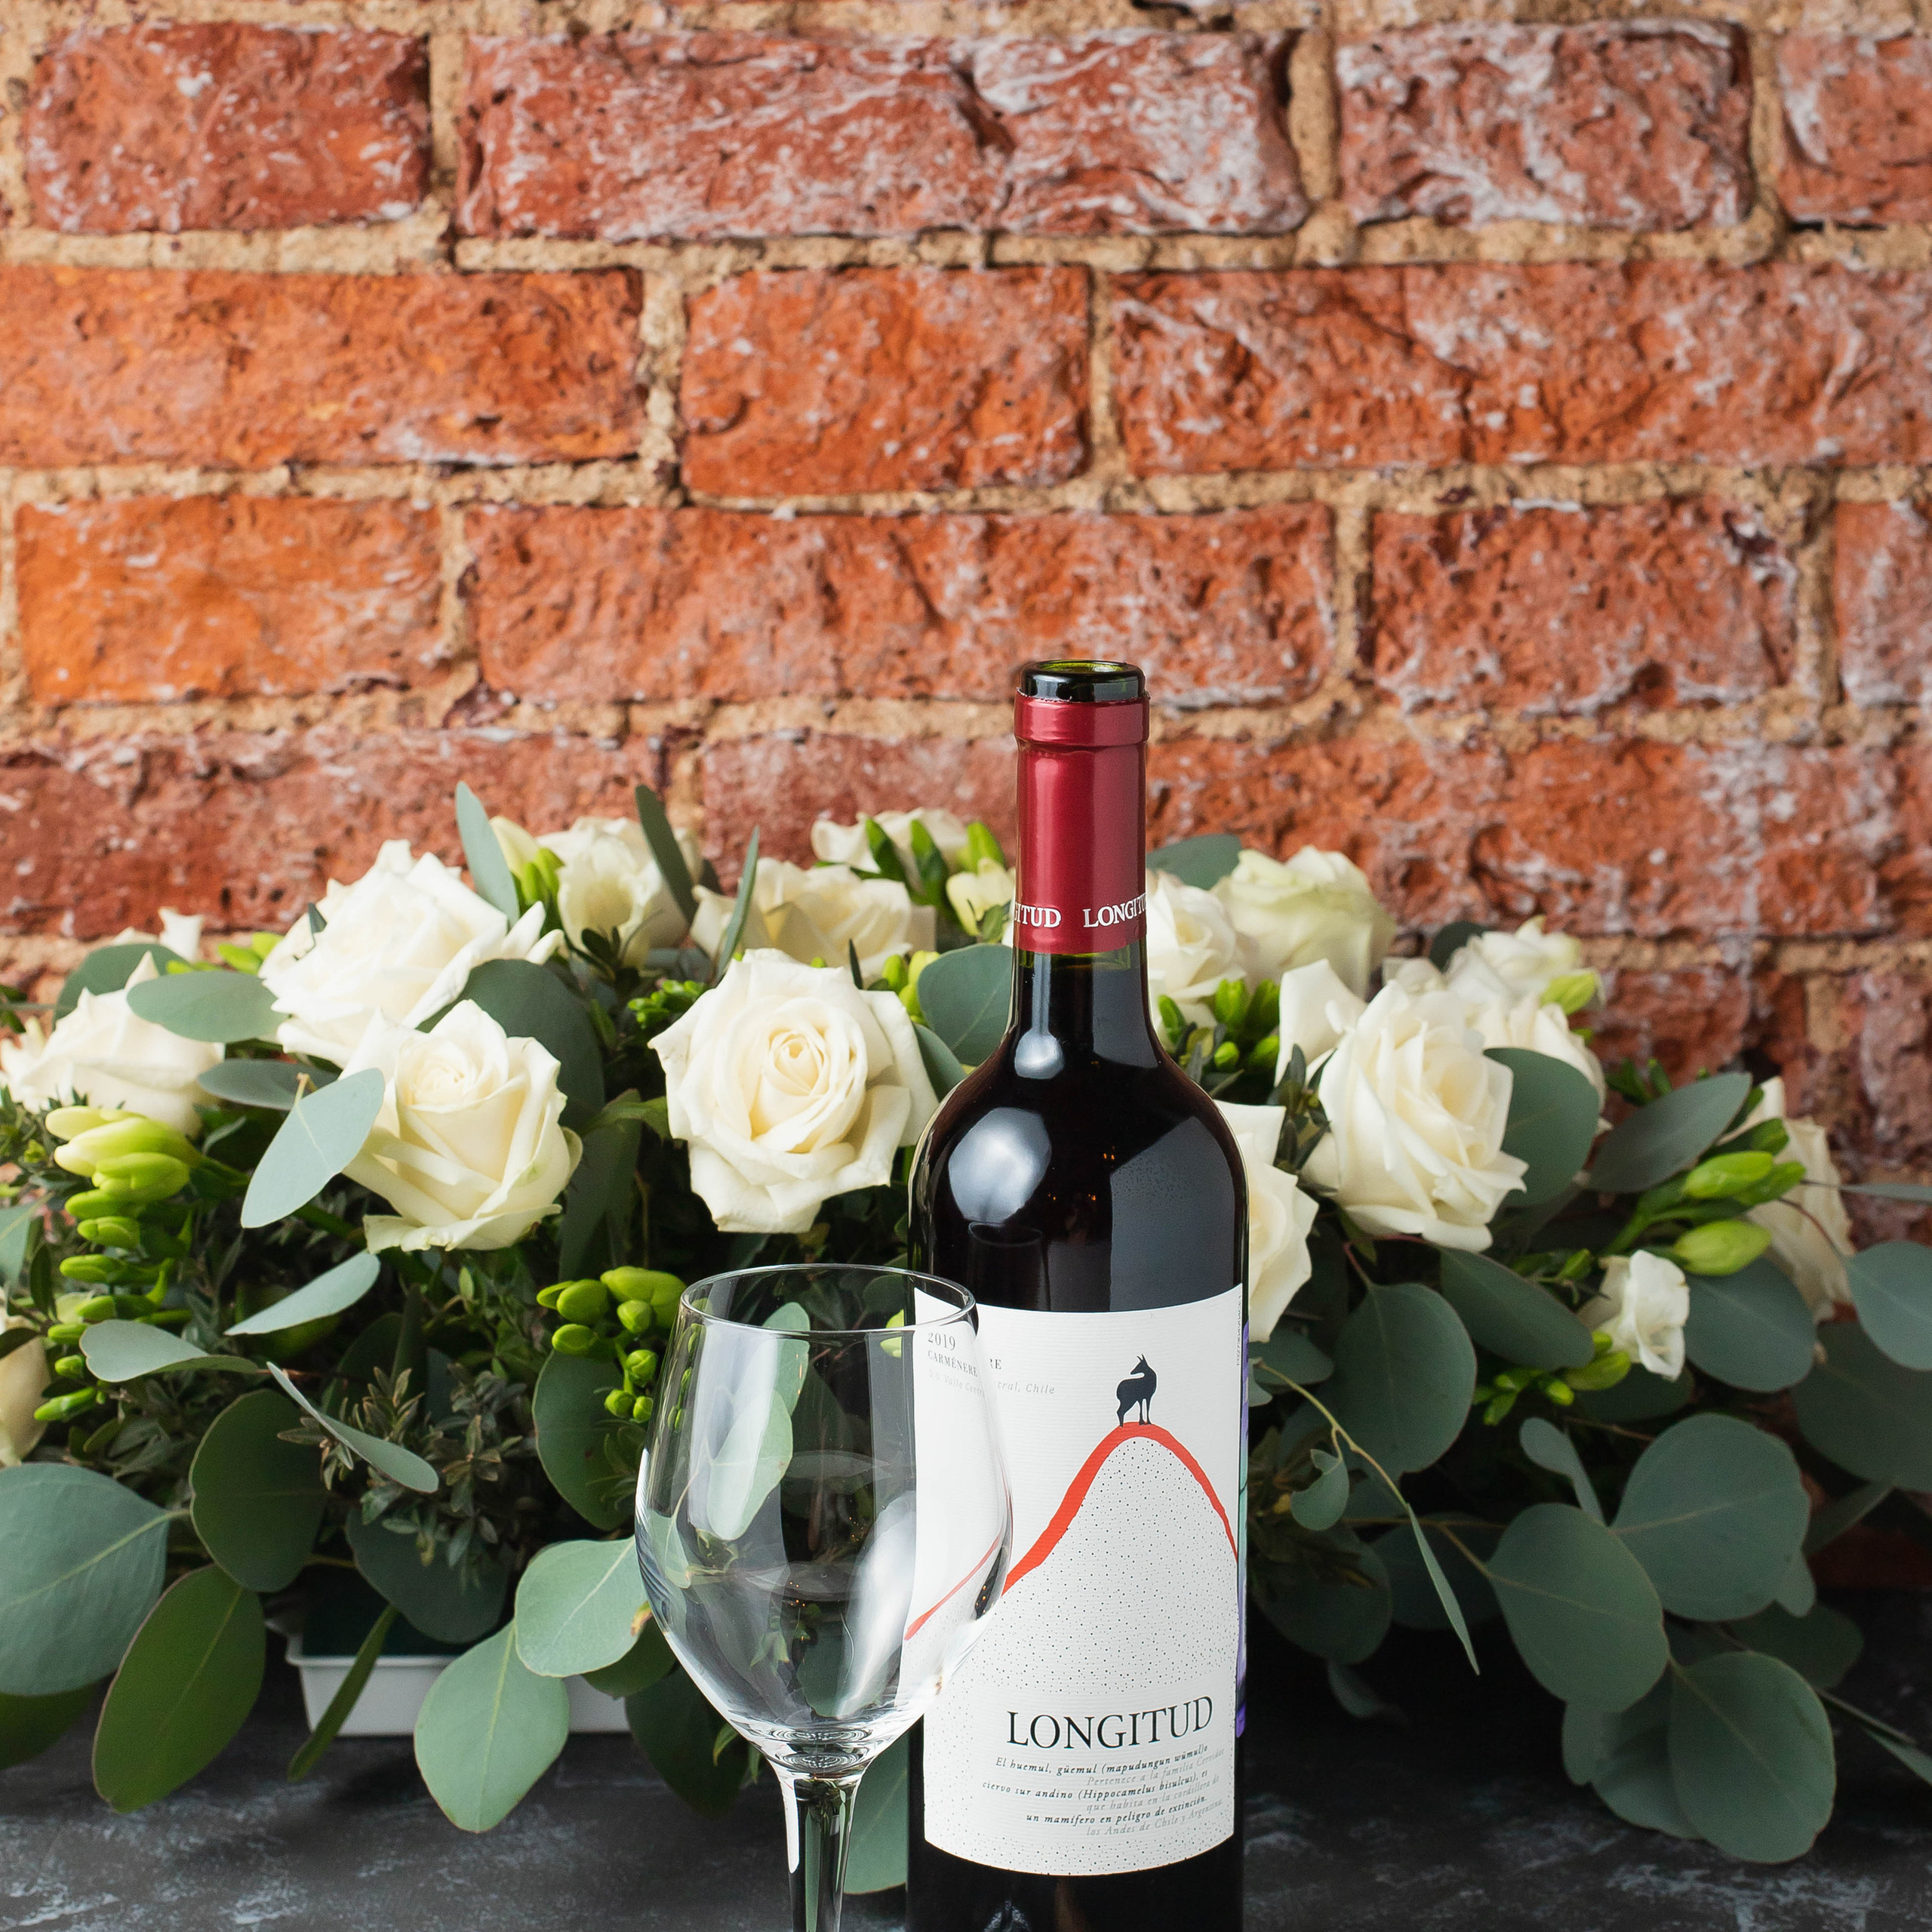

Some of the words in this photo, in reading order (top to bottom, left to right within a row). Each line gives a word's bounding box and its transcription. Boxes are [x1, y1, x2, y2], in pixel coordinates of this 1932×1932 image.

[928, 1331, 955, 1351] 2019
[928, 1349, 978, 1377] CARMÉNERE
[944, 1374, 964, 1389] Valle
[1026, 1382, 1055, 1395] Chile
[1007, 1696, 1214, 1749] LONGITUD
[995, 1756, 1007, 1767] El
[1010, 1759, 1051, 1774] huemul,
[1057, 1764, 1097, 1776] güemul
[1102, 1758, 1171, 1774] (mapudungun
[1087, 1776, 1136, 1786] Pertenece
[1149, 1770, 1158, 1780] la
[1161, 1762, 1193, 1780] familia
[982, 1780, 1011, 1793] ciervo
[1014, 1787, 1031, 1796] sur
[1035, 1789, 1073, 1799] andino
[1078, 1784, 1155, 1801] (Hippocamelus
[1159, 1771, 1198, 1790] bisulcus),
[1044, 1814, 1095, 1826] mamífero
[1115, 1810, 1151, 1825] peligro
[1155, 1806, 1165, 1817] de
[1168, 1795, 1208, 1814] extinción.
[1087, 1804, 1106, 1814] que
[1109, 1798, 1143, 1810] habita
[1162, 1792, 1171, 1802] la
[1087, 1826, 1100, 1835] los
[1103, 1823, 1135, 1835] Andes
[1139, 1821, 1151, 1832] de
[1155, 1814, 1178, 1829] Chile
